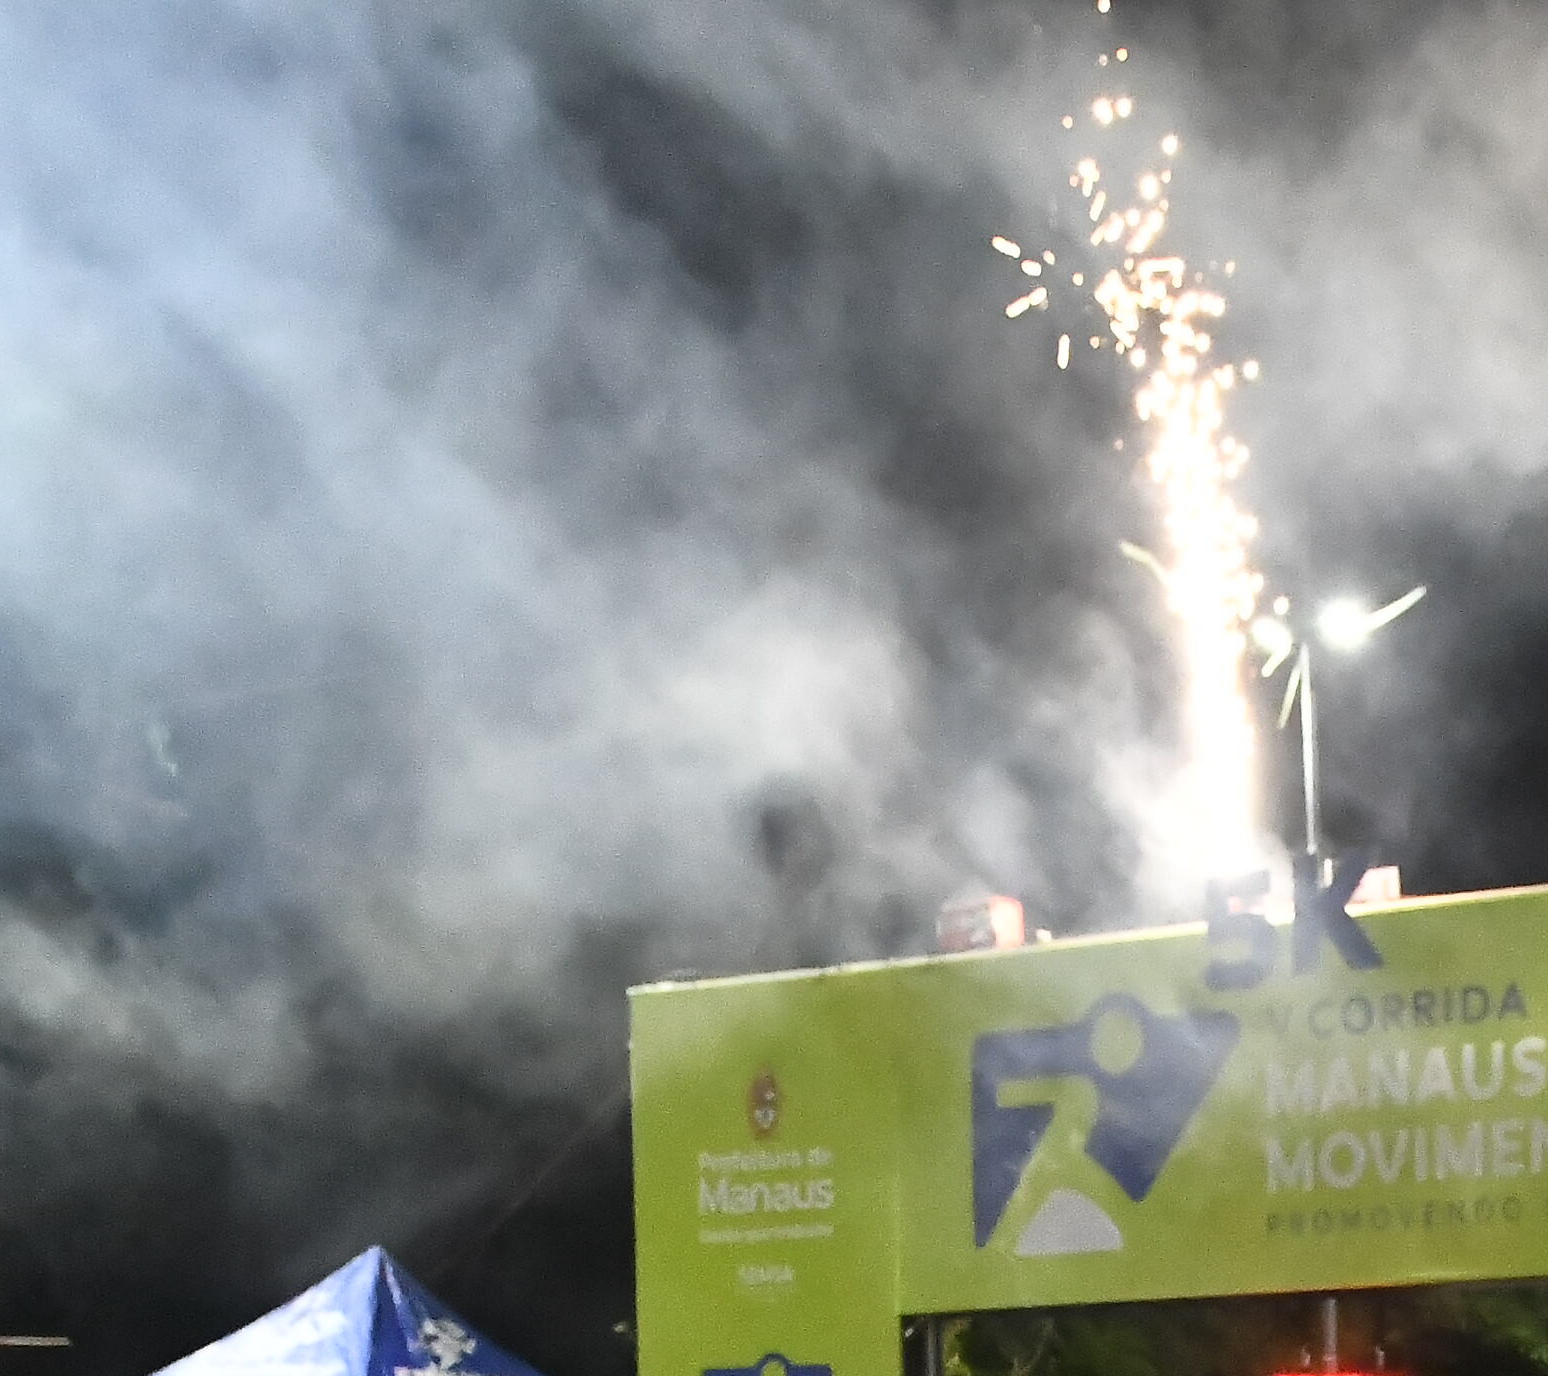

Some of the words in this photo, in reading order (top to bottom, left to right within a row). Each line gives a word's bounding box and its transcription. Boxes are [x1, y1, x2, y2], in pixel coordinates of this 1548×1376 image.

[1204, 853, 1384, 991] 5K
[1308, 982, 1529, 1039] CORRIDA
[699, 1177, 835, 1216] Manaus
